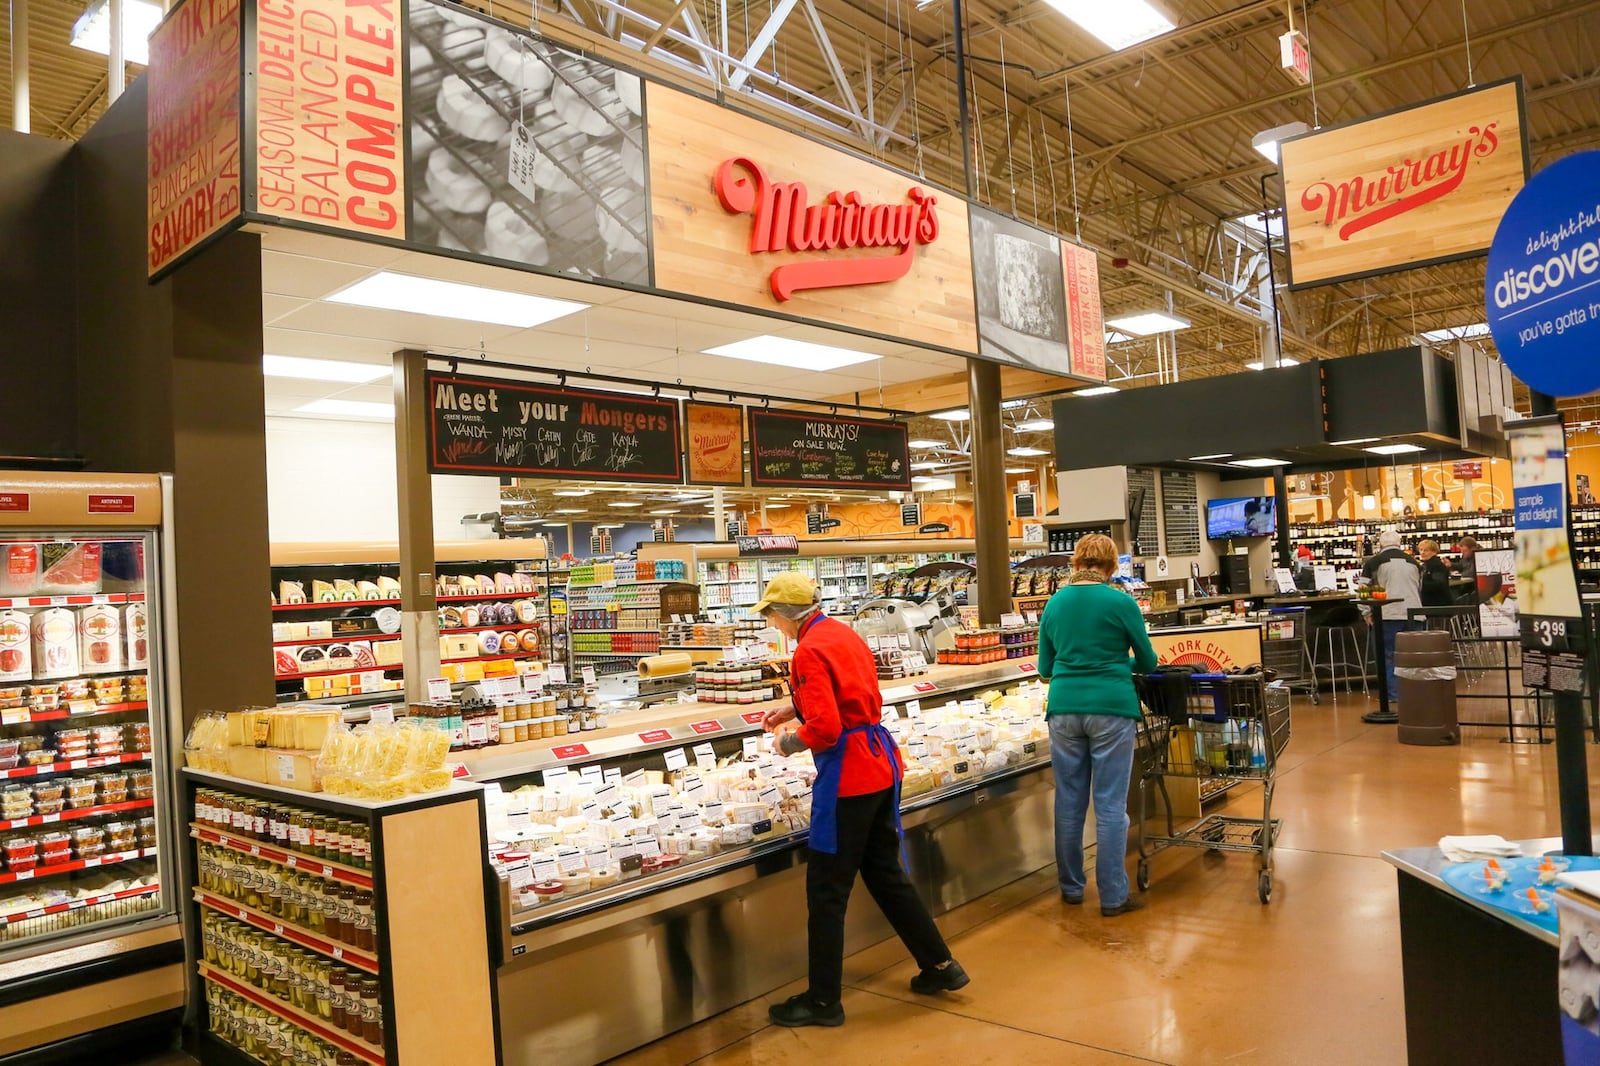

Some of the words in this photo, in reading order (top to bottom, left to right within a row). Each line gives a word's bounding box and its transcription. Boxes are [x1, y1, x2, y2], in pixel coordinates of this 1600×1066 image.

[258, 0, 295, 82] DELIC
[151, 79, 217, 178] SHARP
[300, 9, 339, 221] BALANCED
[258, 87, 295, 211] SEASONAL
[151, 134, 217, 218] PUNGENT
[1300, 120, 1499, 241] Murray's
[151, 180, 217, 268] SAVORY
[714, 157, 940, 301] Murray's
[1493, 239, 1600, 308] discove
[1080, 300, 1092, 336] YORK
[1518, 320, 1553, 347] you've
[1555, 307, 1587, 335] gotta
[1083, 344, 1095, 375] NEW
[435, 383, 499, 413] Meet
[519, 401, 568, 424] your
[580, 402, 668, 433] Mongers
[448, 422, 492, 438] WANDA
[502, 426, 528, 440] MISSY
[793, 440, 805, 448] ON
[806, 440, 825, 449] SALE
[805, 421, 860, 443] MURRAY'S!
[1518, 493, 1544, 508] sample
[1519, 509, 1532, 521] and
[1532, 507, 1558, 522] delight
[1168, 639, 1201, 656] YORK
[1206, 642, 1234, 666] CITY'
